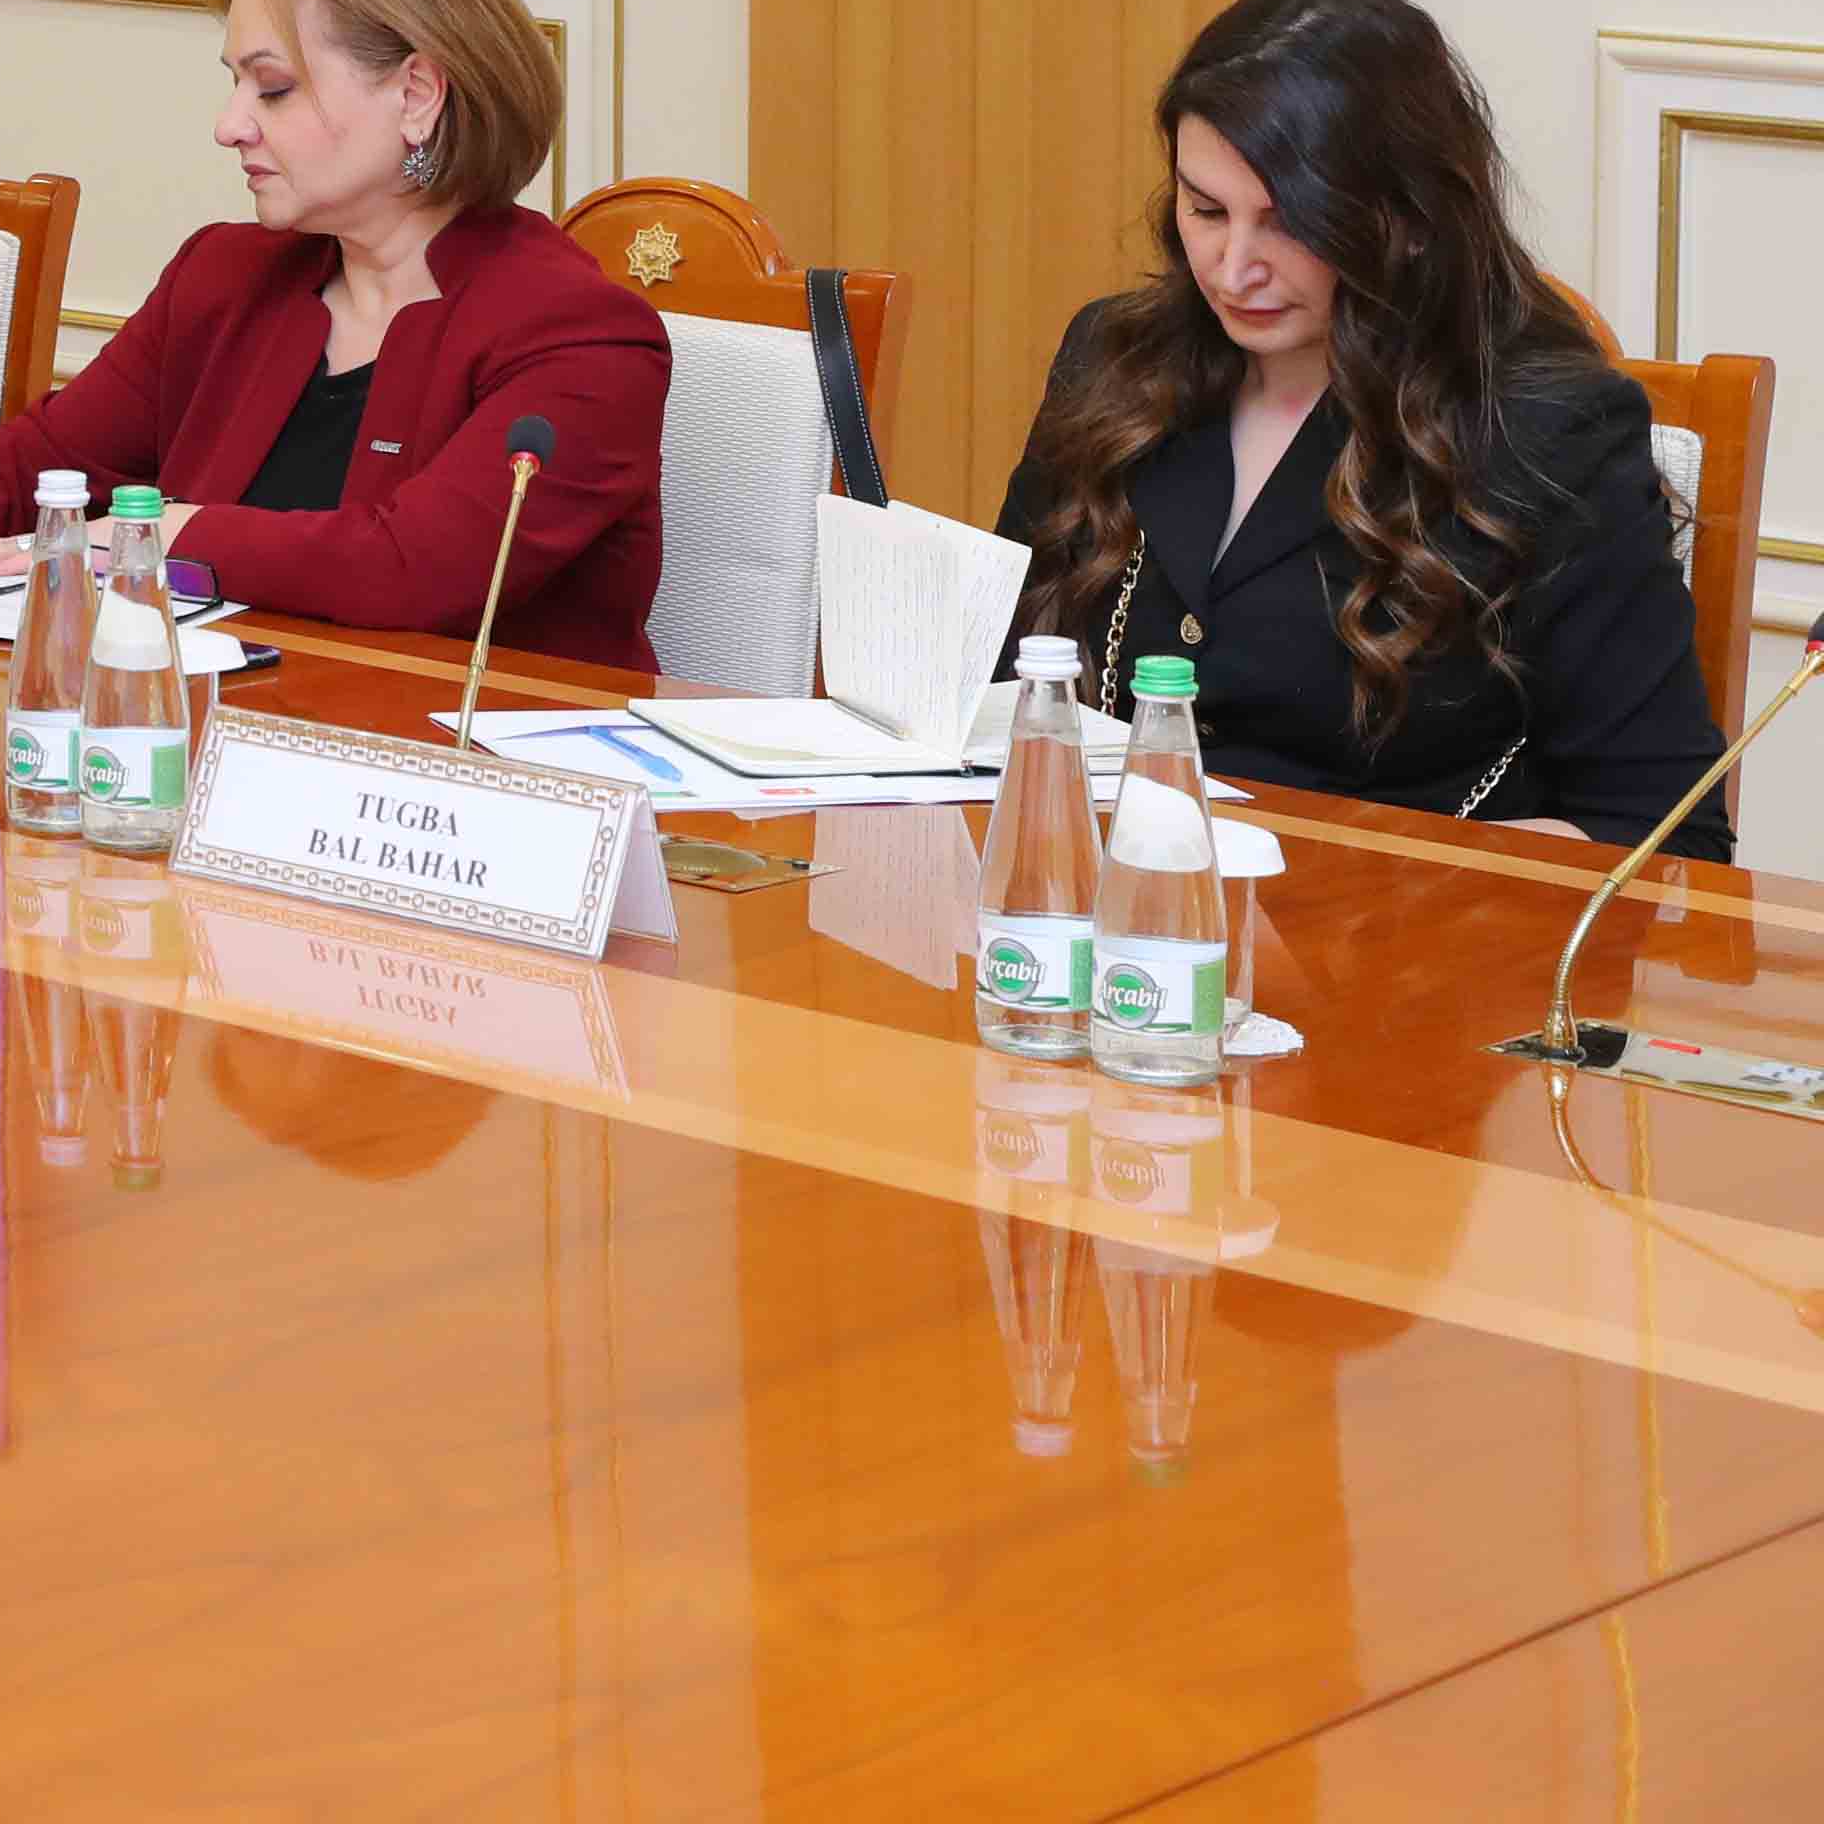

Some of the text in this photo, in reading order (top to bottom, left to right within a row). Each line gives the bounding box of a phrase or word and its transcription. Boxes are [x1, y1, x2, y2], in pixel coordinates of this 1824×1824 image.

[356, 791, 459, 837] TUGBA
[308, 828, 488, 889] BAL BAHAR
